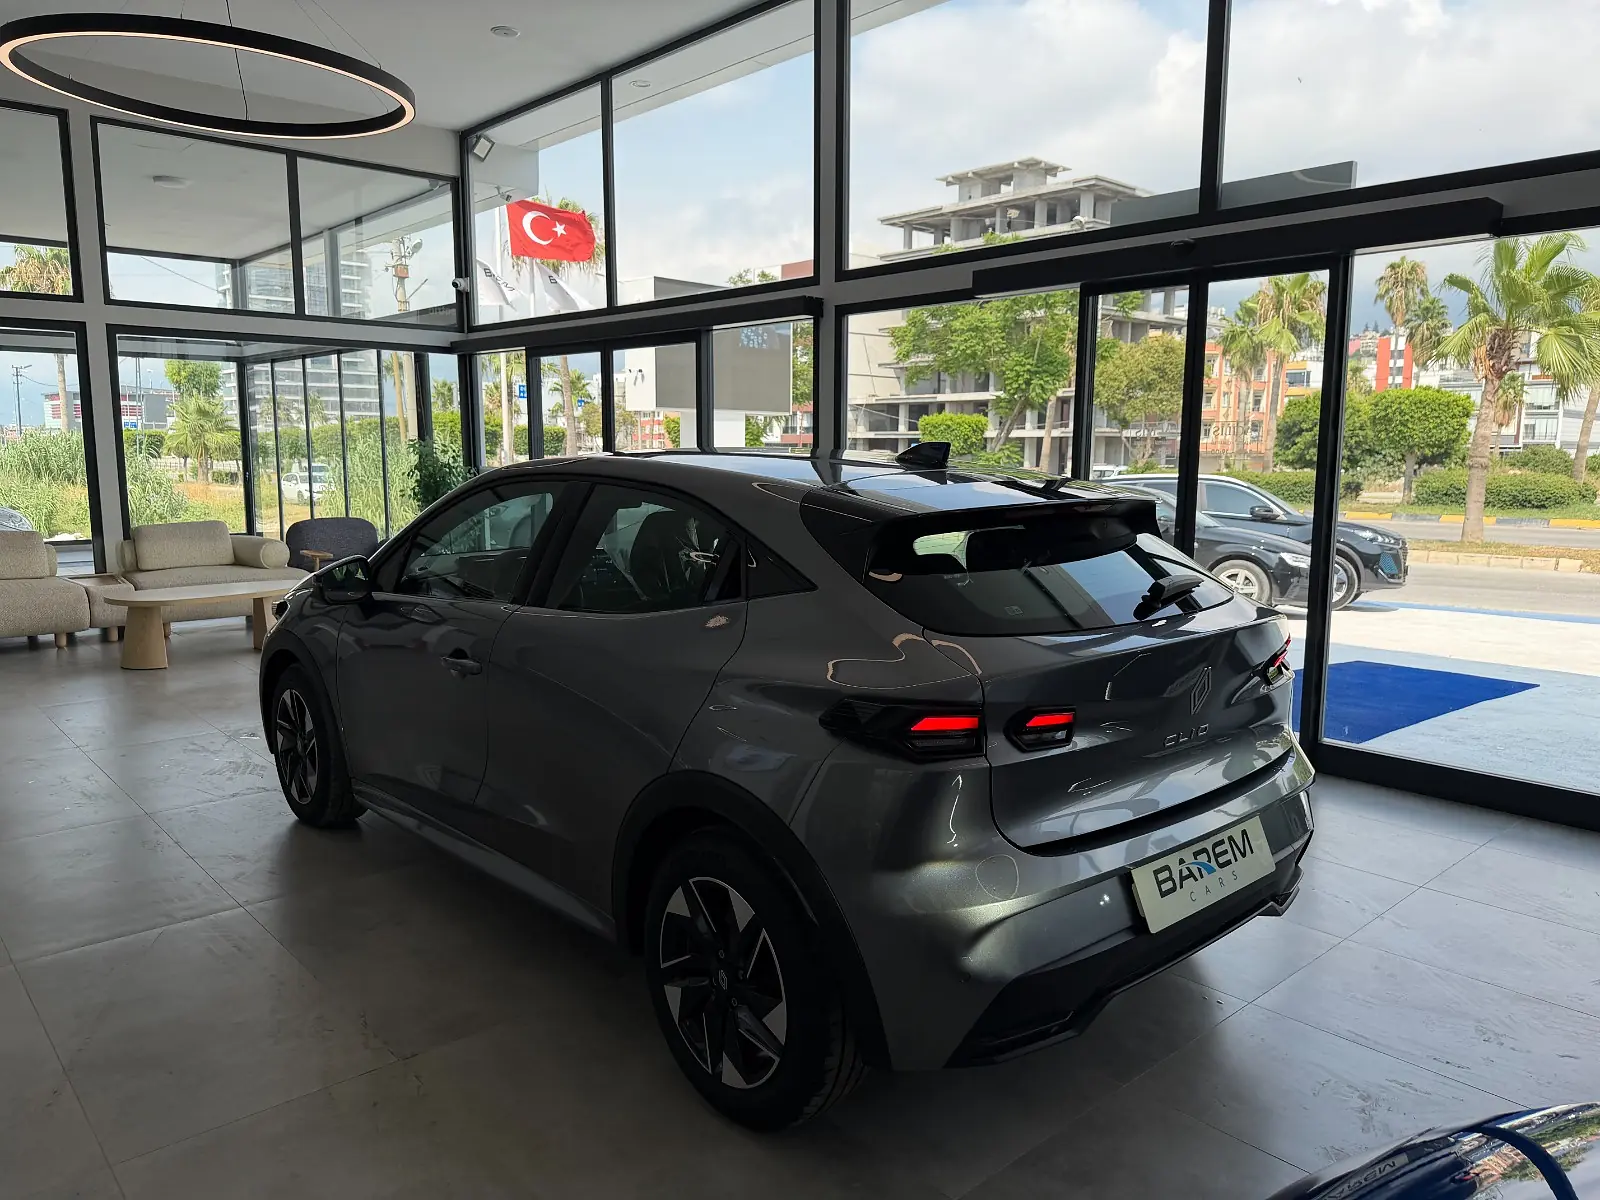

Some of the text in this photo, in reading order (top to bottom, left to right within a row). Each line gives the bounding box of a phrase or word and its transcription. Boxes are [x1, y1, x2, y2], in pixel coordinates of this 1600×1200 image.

[1163, 723, 1209, 748] CLIO
[1152, 828, 1254, 899] BAREM
[1189, 871, 1238, 902] CARS
